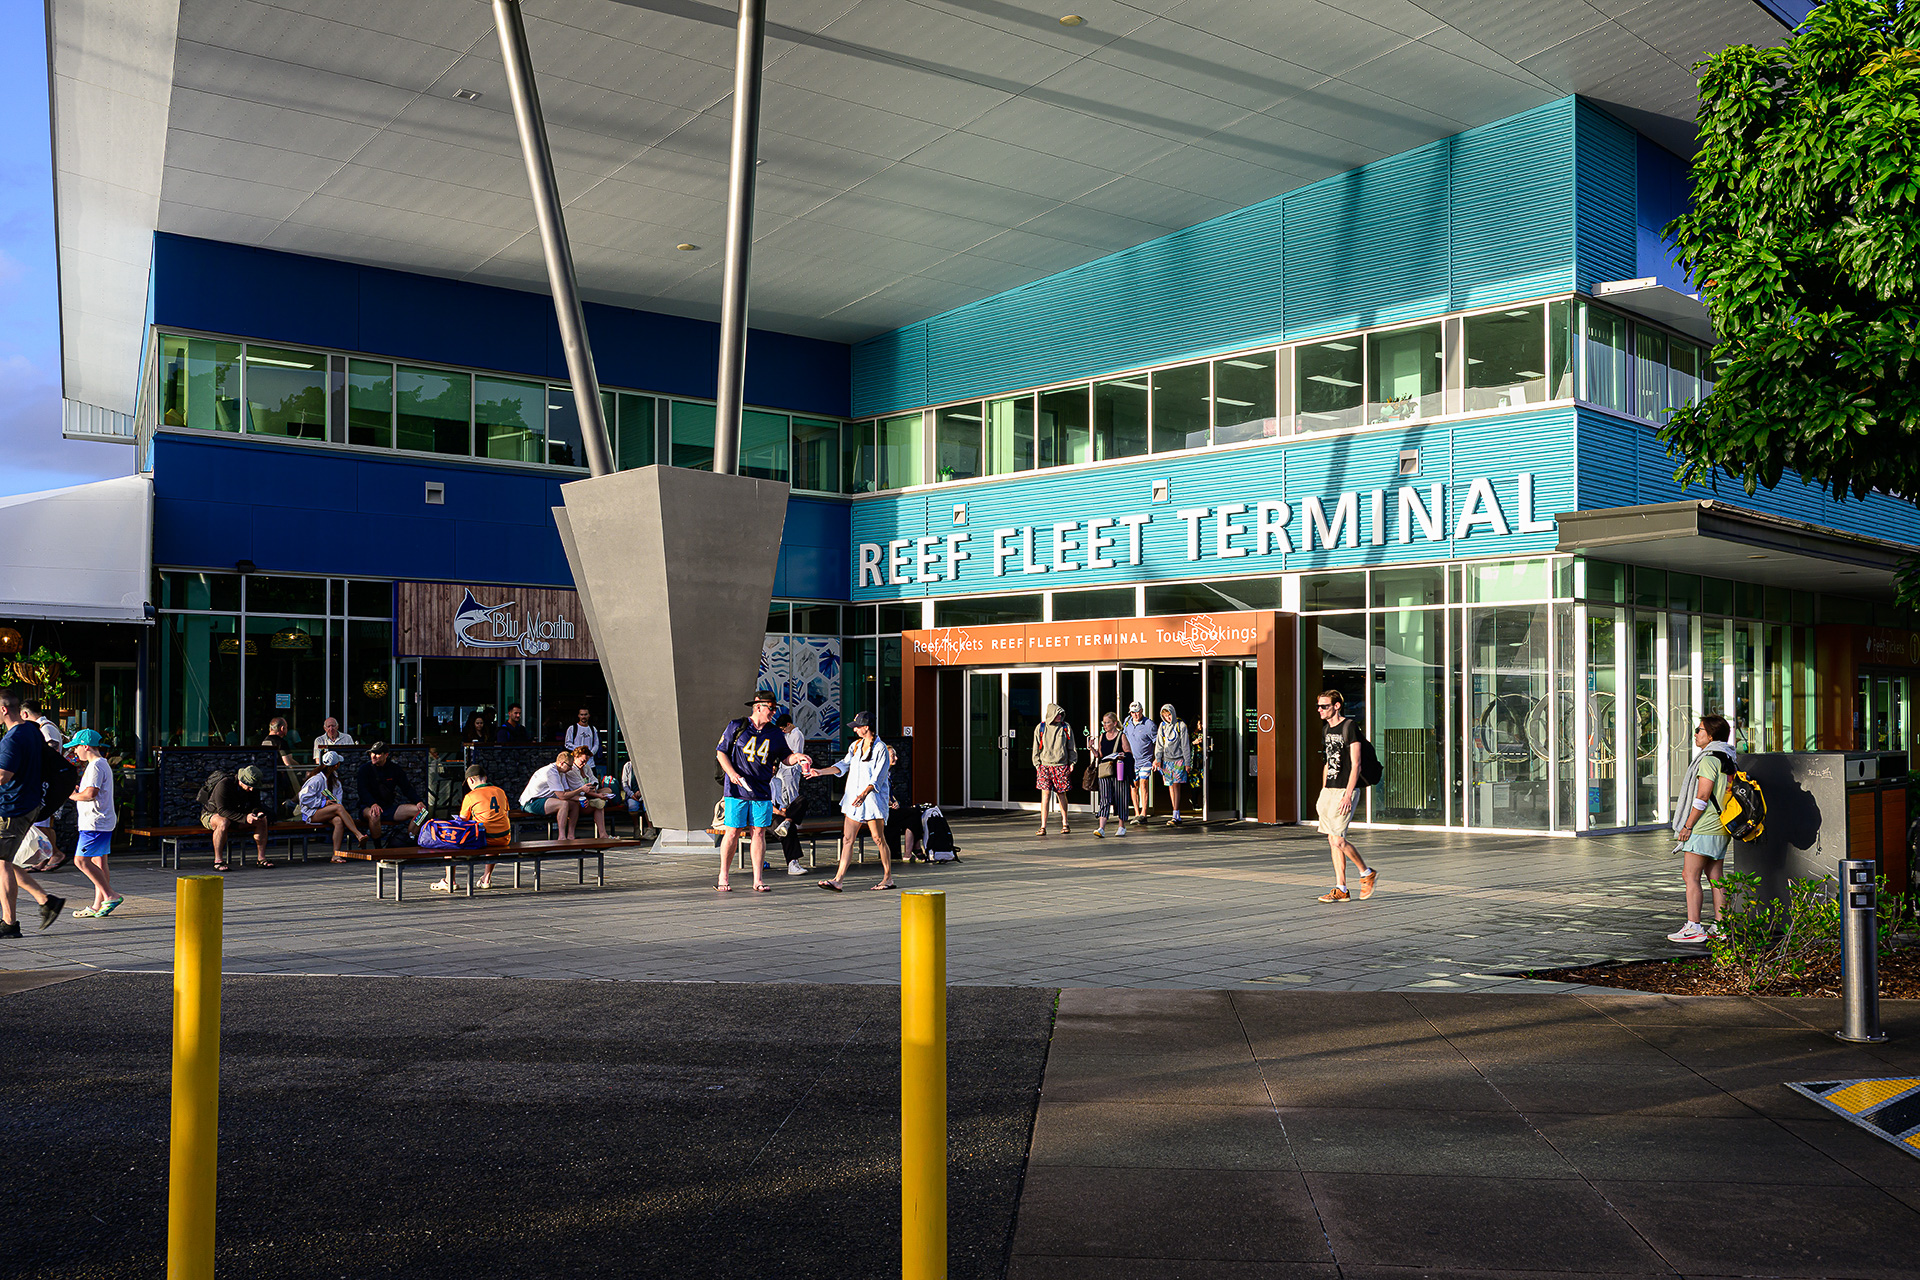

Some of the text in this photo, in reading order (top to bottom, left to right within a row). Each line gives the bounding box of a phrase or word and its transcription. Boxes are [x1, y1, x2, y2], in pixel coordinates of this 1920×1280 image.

[859, 473, 1556, 587] REEF FLEET TERMINAL
[493, 611, 574, 641] Blu Marlin
[1191, 626, 1257, 643] Bookings
[914, 637, 983, 653] Reef Tickets
[991, 632, 1147, 649] REEF FLEET TERMINAL
[743, 736, 770, 764] 44
[489, 796, 500, 814] 4
